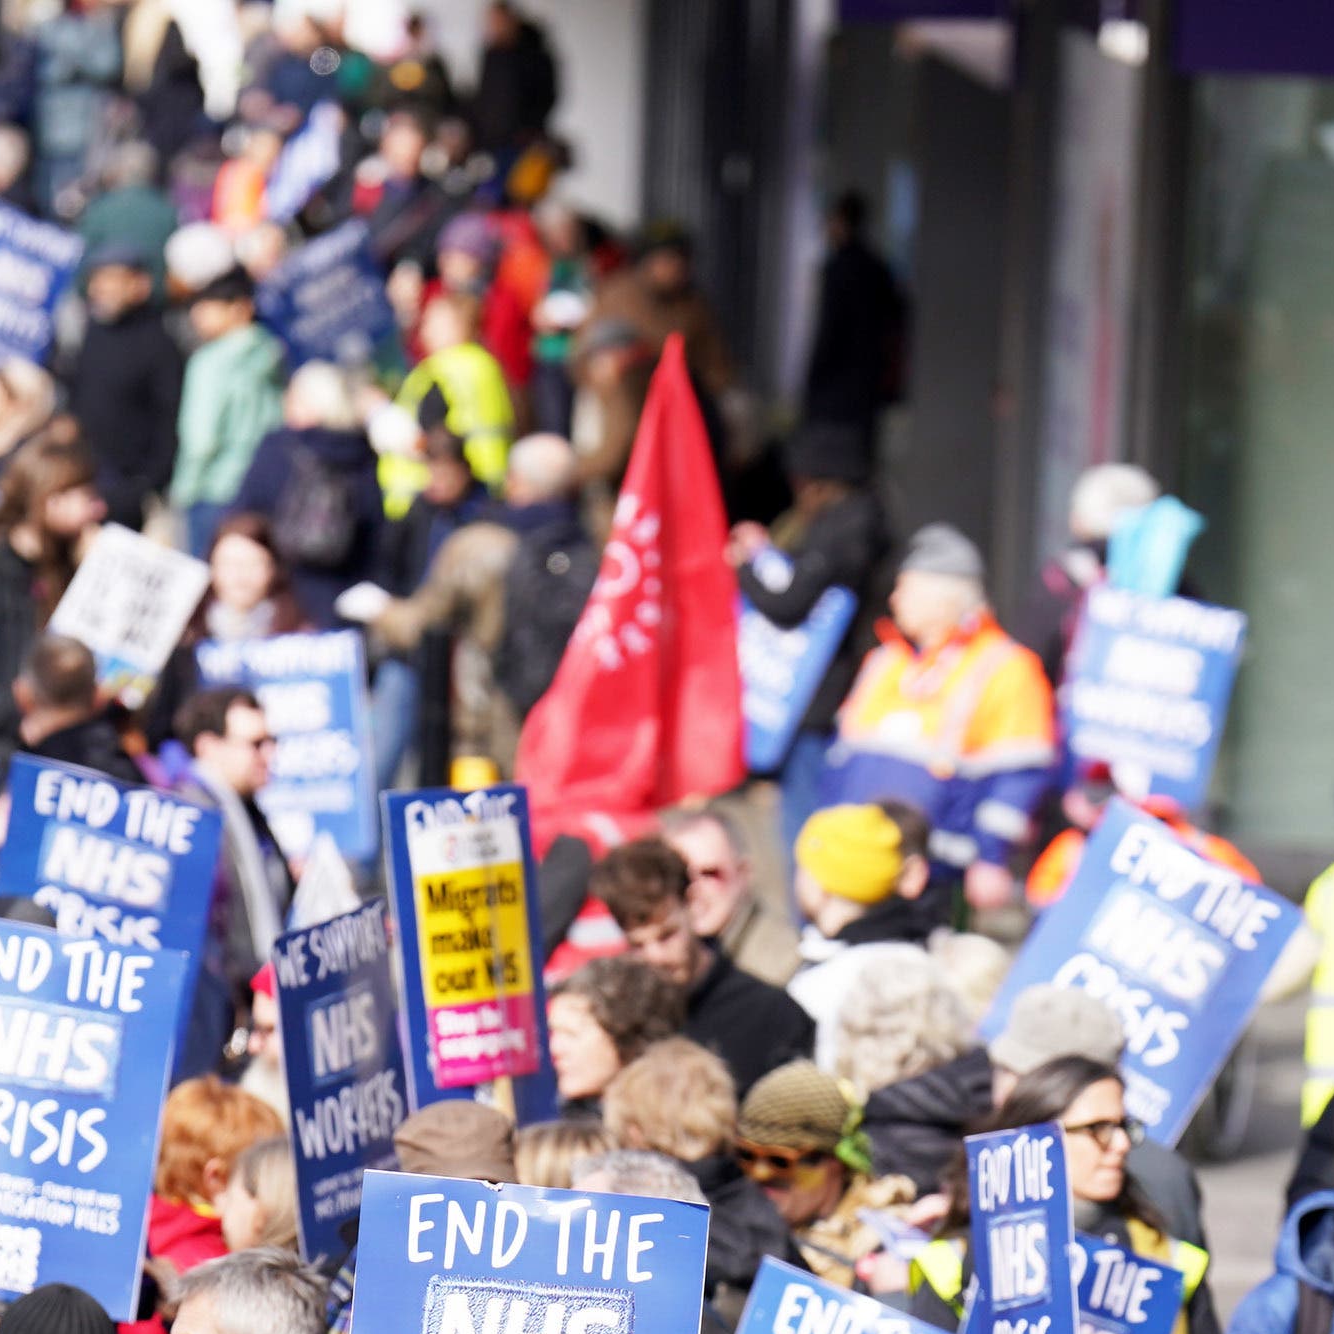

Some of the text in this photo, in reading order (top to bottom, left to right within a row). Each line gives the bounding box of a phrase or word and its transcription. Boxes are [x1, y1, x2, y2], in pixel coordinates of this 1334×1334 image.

[33, 769, 121, 829] END
[123, 788, 203, 855] THE
[43, 829, 165, 908] NHS
[1189, 854, 1282, 951] THE
[62, 939, 154, 1013] THE
[275, 905, 385, 988] WE SUPPORT
[1086, 897, 1225, 1001] NHS
[312, 993, 377, 1079] NHS
[294, 1066, 405, 1162] WORKERS
[978, 1133, 1055, 1212] END THE
[407, 1192, 528, 1270] END
[544, 1198, 664, 1283] THE
[988, 1222, 1048, 1302] NHS
[1090, 1248, 1164, 1324] THE
